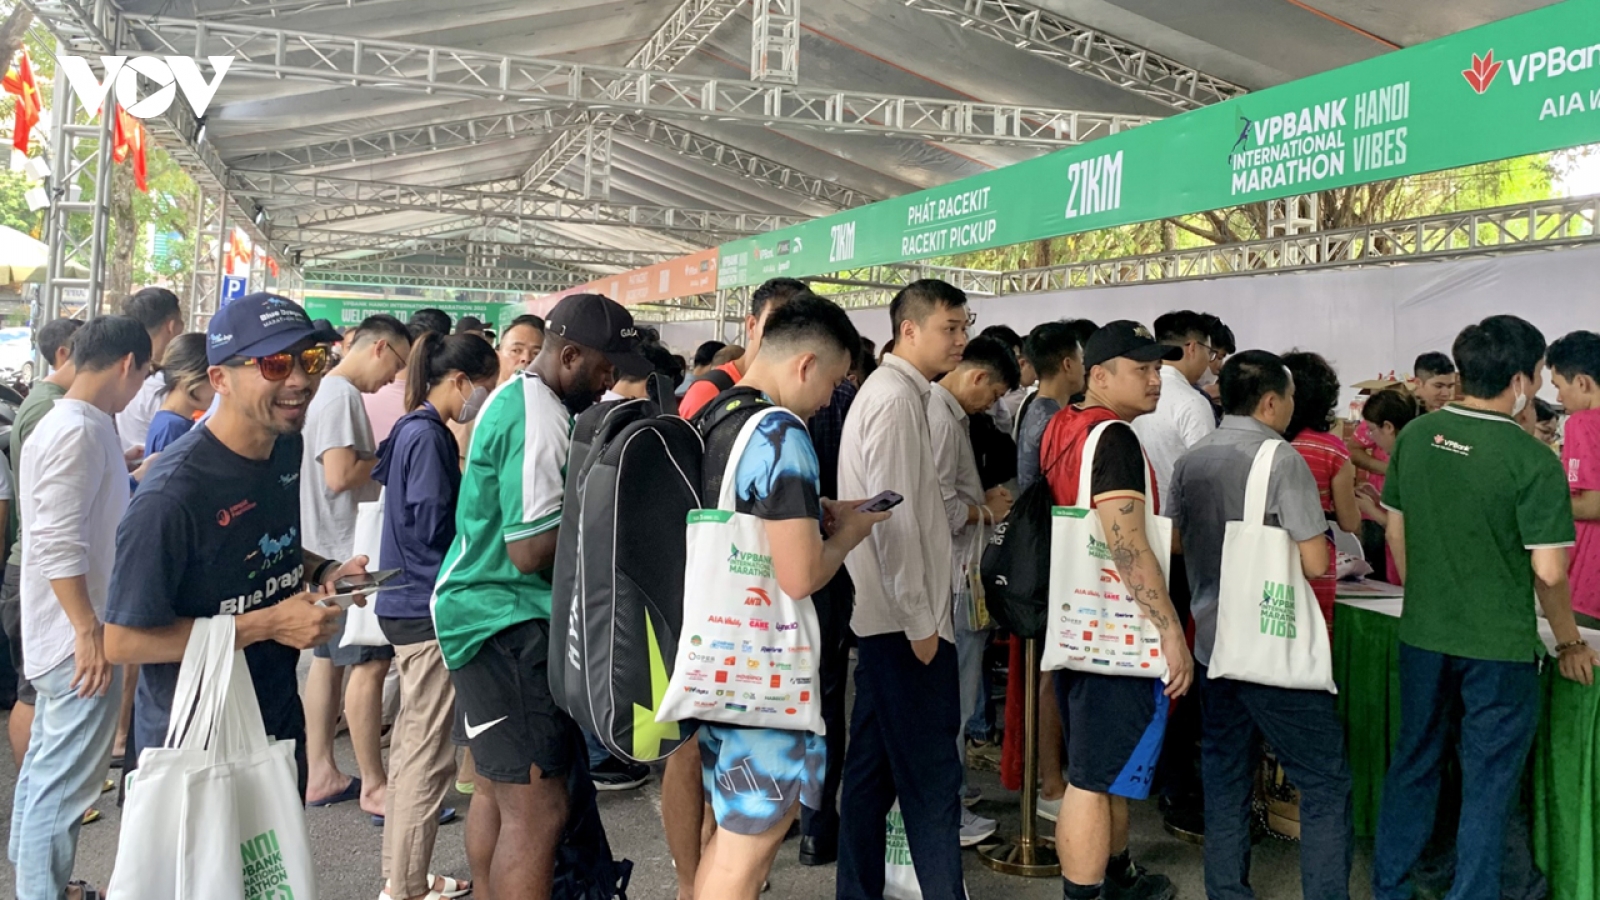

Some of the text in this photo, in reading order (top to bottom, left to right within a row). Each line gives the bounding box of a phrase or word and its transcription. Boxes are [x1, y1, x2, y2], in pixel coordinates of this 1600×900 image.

[1254, 97, 1347, 146] VPBANK
[1354, 81, 1410, 130] HANOI
[1539, 91, 1585, 121] AIA
[1232, 129, 1345, 171] INTERNATIONAL
[1353, 126, 1407, 172] VIBES
[1065, 150, 1124, 219] 21KM
[1231, 150, 1345, 195] MARATHON
[907, 186, 991, 226] PHÁT RACEKIT
[829, 220, 857, 263] 21KM
[901, 219, 997, 257] RACEKIT PICKUP
[228, 279, 241, 298] P
[259, 309, 280, 322] Blue
[219, 588, 263, 615] Blue
